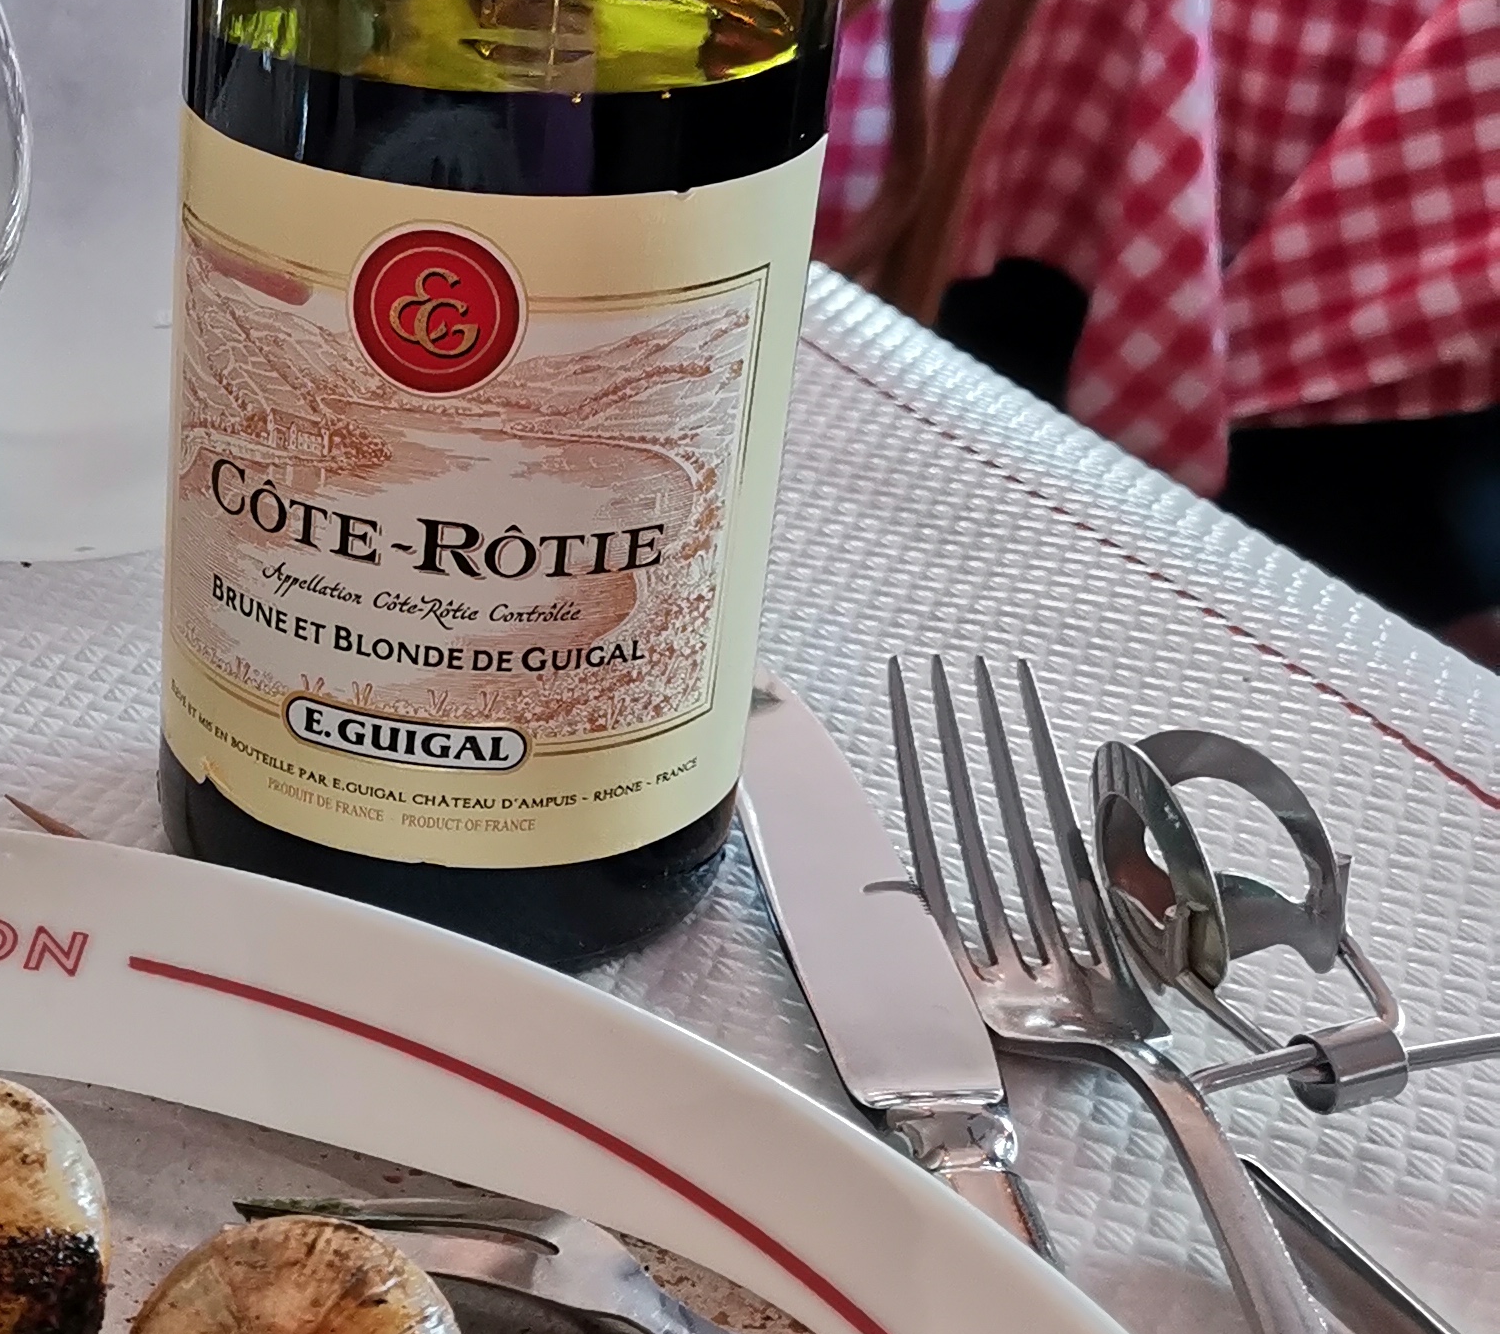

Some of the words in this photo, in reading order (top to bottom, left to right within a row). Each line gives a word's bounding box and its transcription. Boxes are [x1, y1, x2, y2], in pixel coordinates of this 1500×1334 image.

[211, 458, 666, 580] CÔTE-RÔTIE
[212, 573, 288, 634] BRUNE
[294, 616, 327, 645] ET
[333, 625, 464, 668] BLONDE
[471, 650, 514, 672] DE
[521, 640, 646, 672] GUIGAL
[262, 561, 363, 605] Appellation
[372, 590, 480, 630] Côte-Rôtie
[488, 601, 582, 624] Contrôlée
[214, 725, 229, 744] EN
[230, 736, 295, 775] BOUTEILLE
[298, 766, 329, 788] PAR
[333, 778, 407, 804] E.GUIGAL
[501, 794, 577, 809] D'AMPUIS
[656, 756, 698, 785] FRANCE
[303, 706, 510, 762] E.GUIGAL
[267, 777, 315, 806] PRODUIT
[316, 794, 333, 810] DE
[335, 800, 385, 822] FRANCE
[401, 813, 461, 831] PRODUCT
[464, 818, 482, 832] OF
[485, 819, 536, 832] FRANCE
